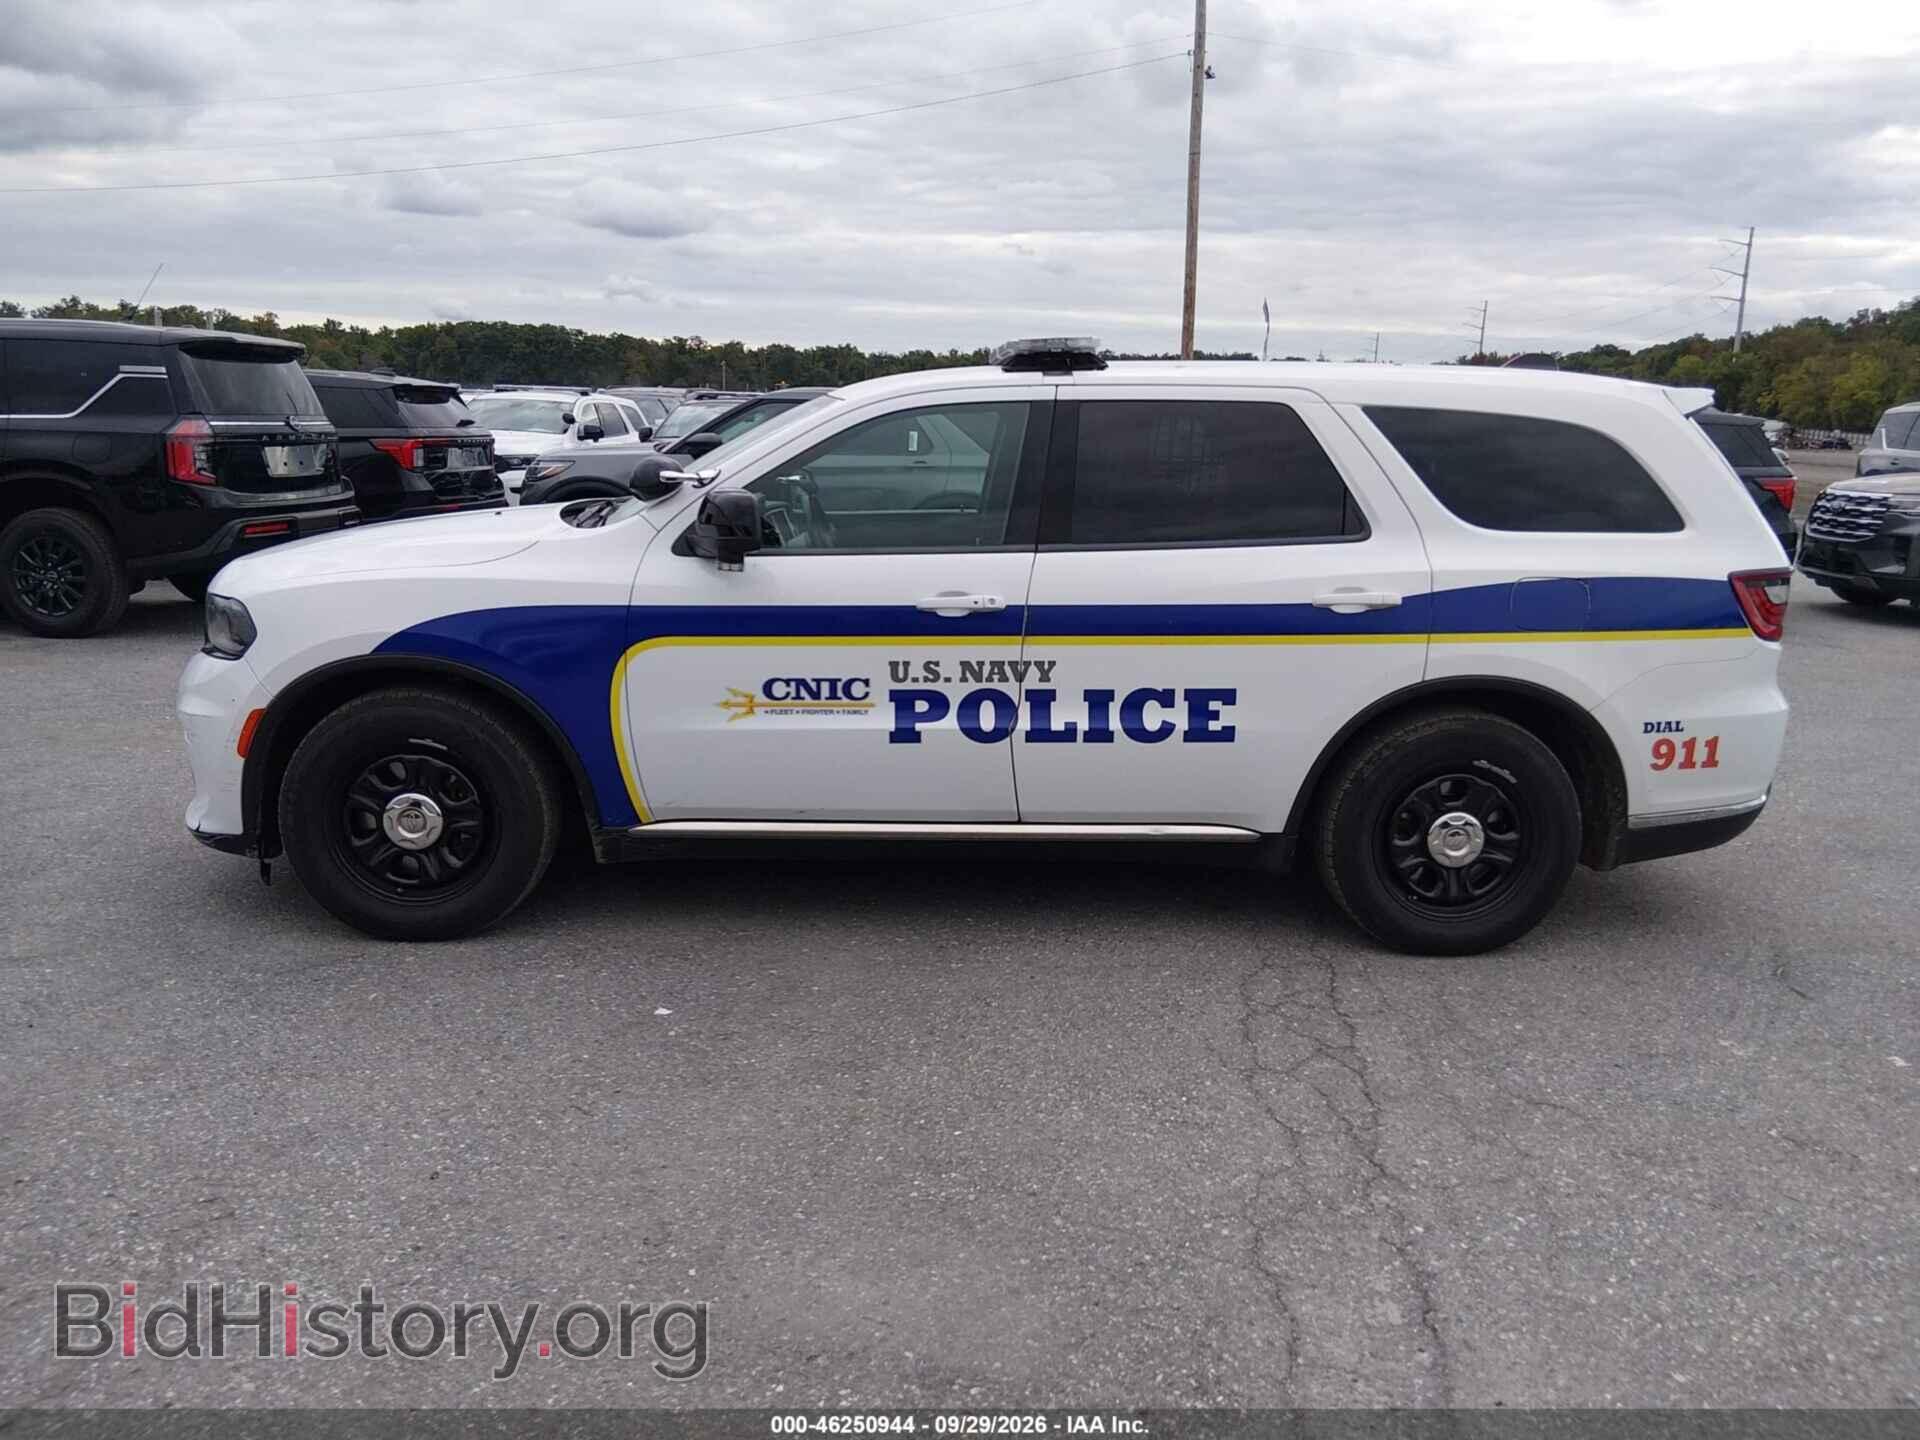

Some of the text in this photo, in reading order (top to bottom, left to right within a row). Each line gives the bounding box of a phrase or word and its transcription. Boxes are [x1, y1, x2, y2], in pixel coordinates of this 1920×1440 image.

[888, 660, 1056, 683] U.S. NAVY
[762, 677, 871, 701] CNIC
[888, 688, 1237, 744] POLICE
[1643, 721, 1684, 734] DIAL
[1649, 736, 1719, 771] 911
